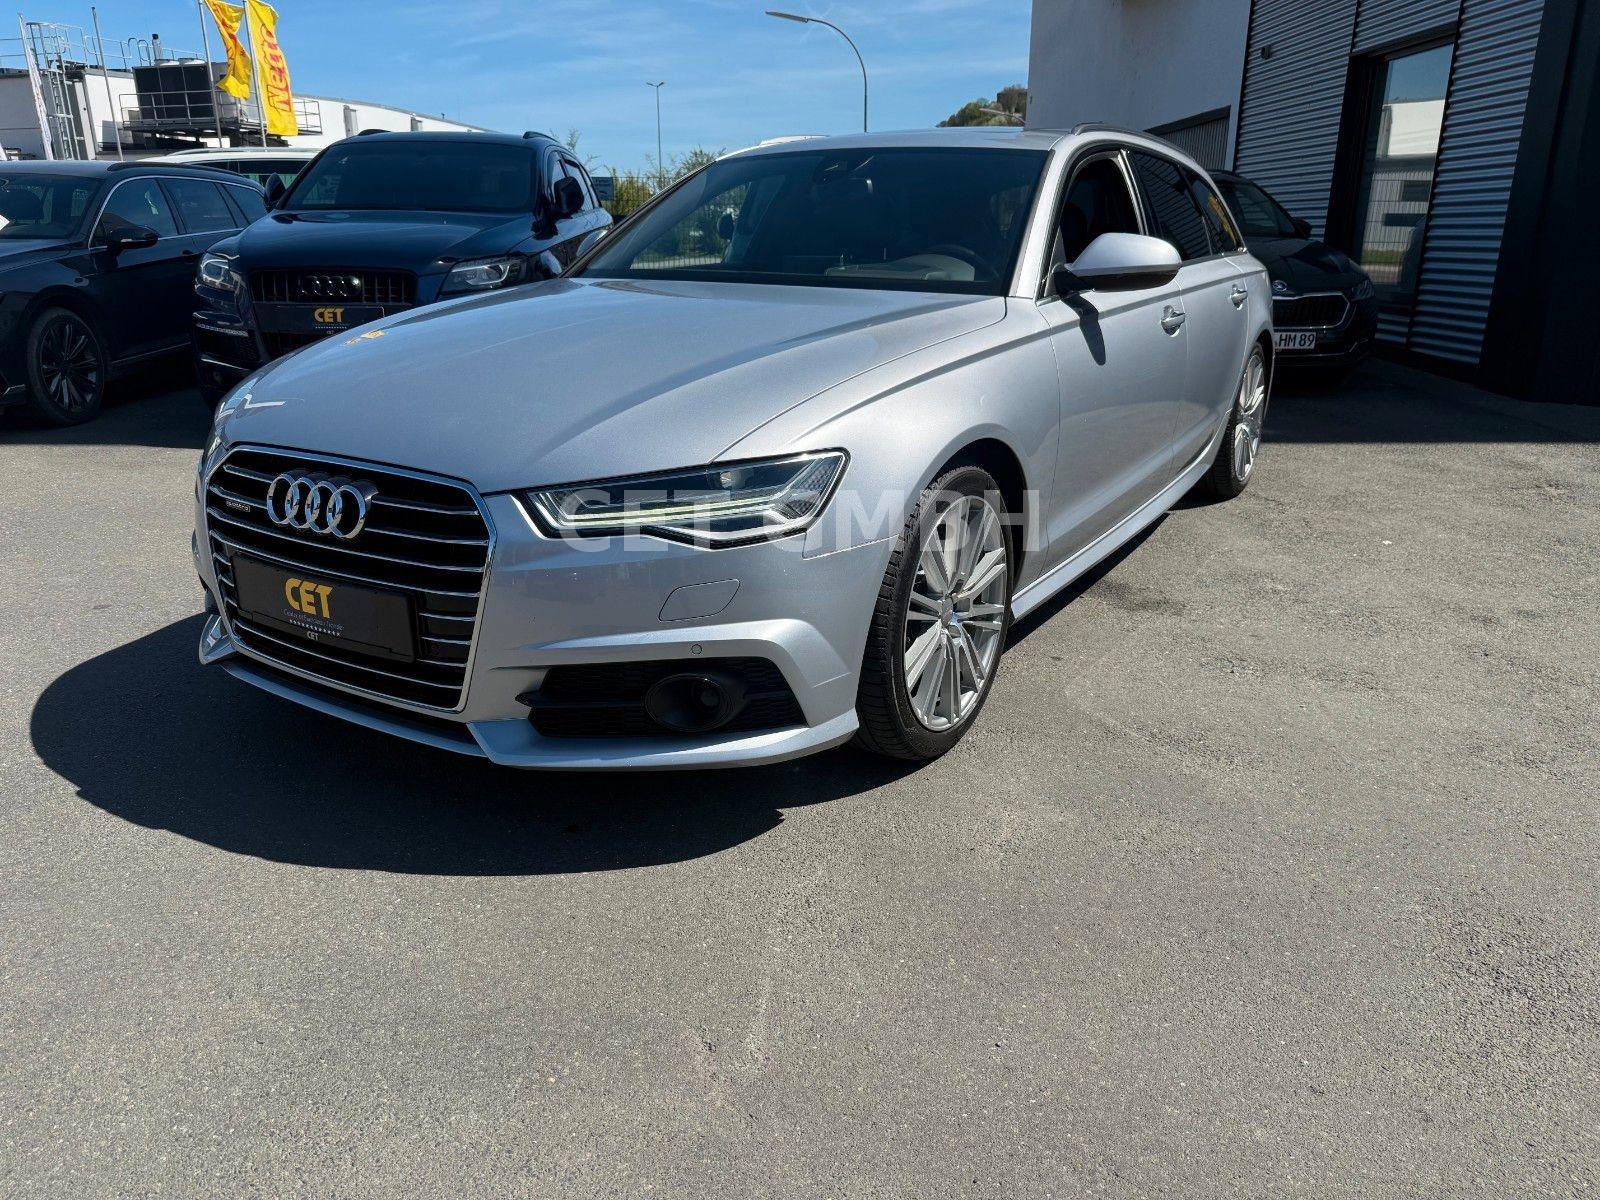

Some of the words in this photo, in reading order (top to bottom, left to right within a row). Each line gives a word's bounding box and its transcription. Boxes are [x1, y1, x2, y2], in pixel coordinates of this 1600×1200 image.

[314, 308, 344, 323] CET
[1279, 333, 1297, 347] HM
[1298, 333, 1315, 347] 89
[285, 578, 333, 619] CET
